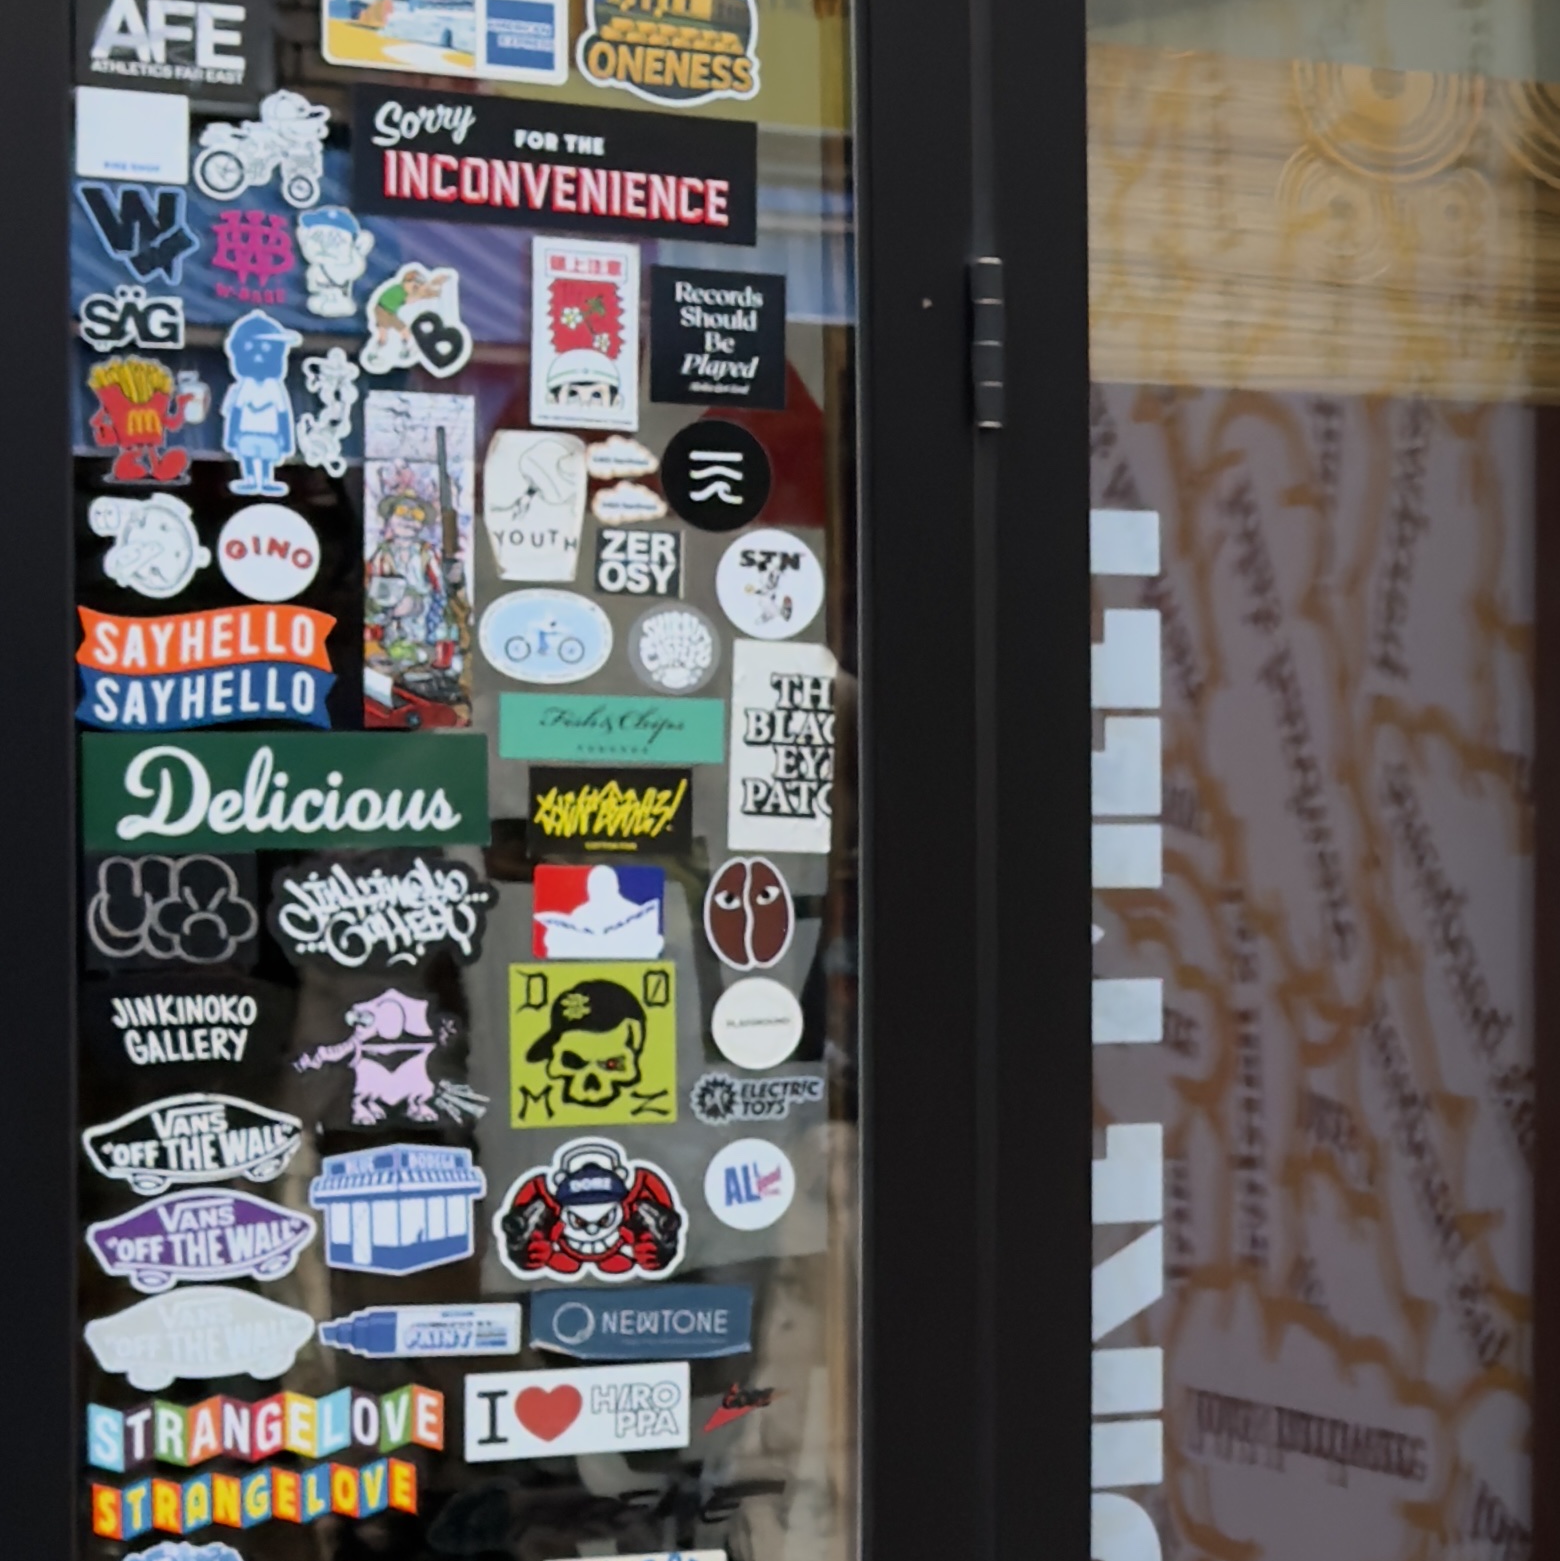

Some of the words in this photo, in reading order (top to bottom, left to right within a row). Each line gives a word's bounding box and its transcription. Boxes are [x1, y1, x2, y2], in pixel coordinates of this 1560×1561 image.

[91, 62, 173, 81] ATHLETICS
[588, 40, 753, 93] ONENESS
[372, 101, 475, 147] Sorry
[515, 129, 559, 151] FOR
[564, 132, 605, 155] THE
[383, 148, 730, 227] INCONVENIENCE
[674, 281, 764, 307] Records
[680, 305, 757, 332] Should
[704, 331, 736, 354] Be
[681, 354, 760, 382] Played
[494, 528, 578, 553] YOUTH
[93, 610, 316, 668] SAYHELLO
[93, 667, 316, 725] SAYHELLO
[773, 673, 834, 711] TH
[116, 746, 462, 840] Delicious
[110, 993, 257, 1029] JINKINOKO
[124, 1029, 249, 1066] GALLERY
[152, 1105, 227, 1136] VANS
[741, 1098, 786, 1116] TOYS
[166, 1136, 220, 1171] THE
[158, 1199, 236, 1229] VANS
[173, 1230, 226, 1266] THE
[94, 1391, 440, 1467] STRANGELOVE
[96, 1461, 413, 1537] STRANGELOVE
